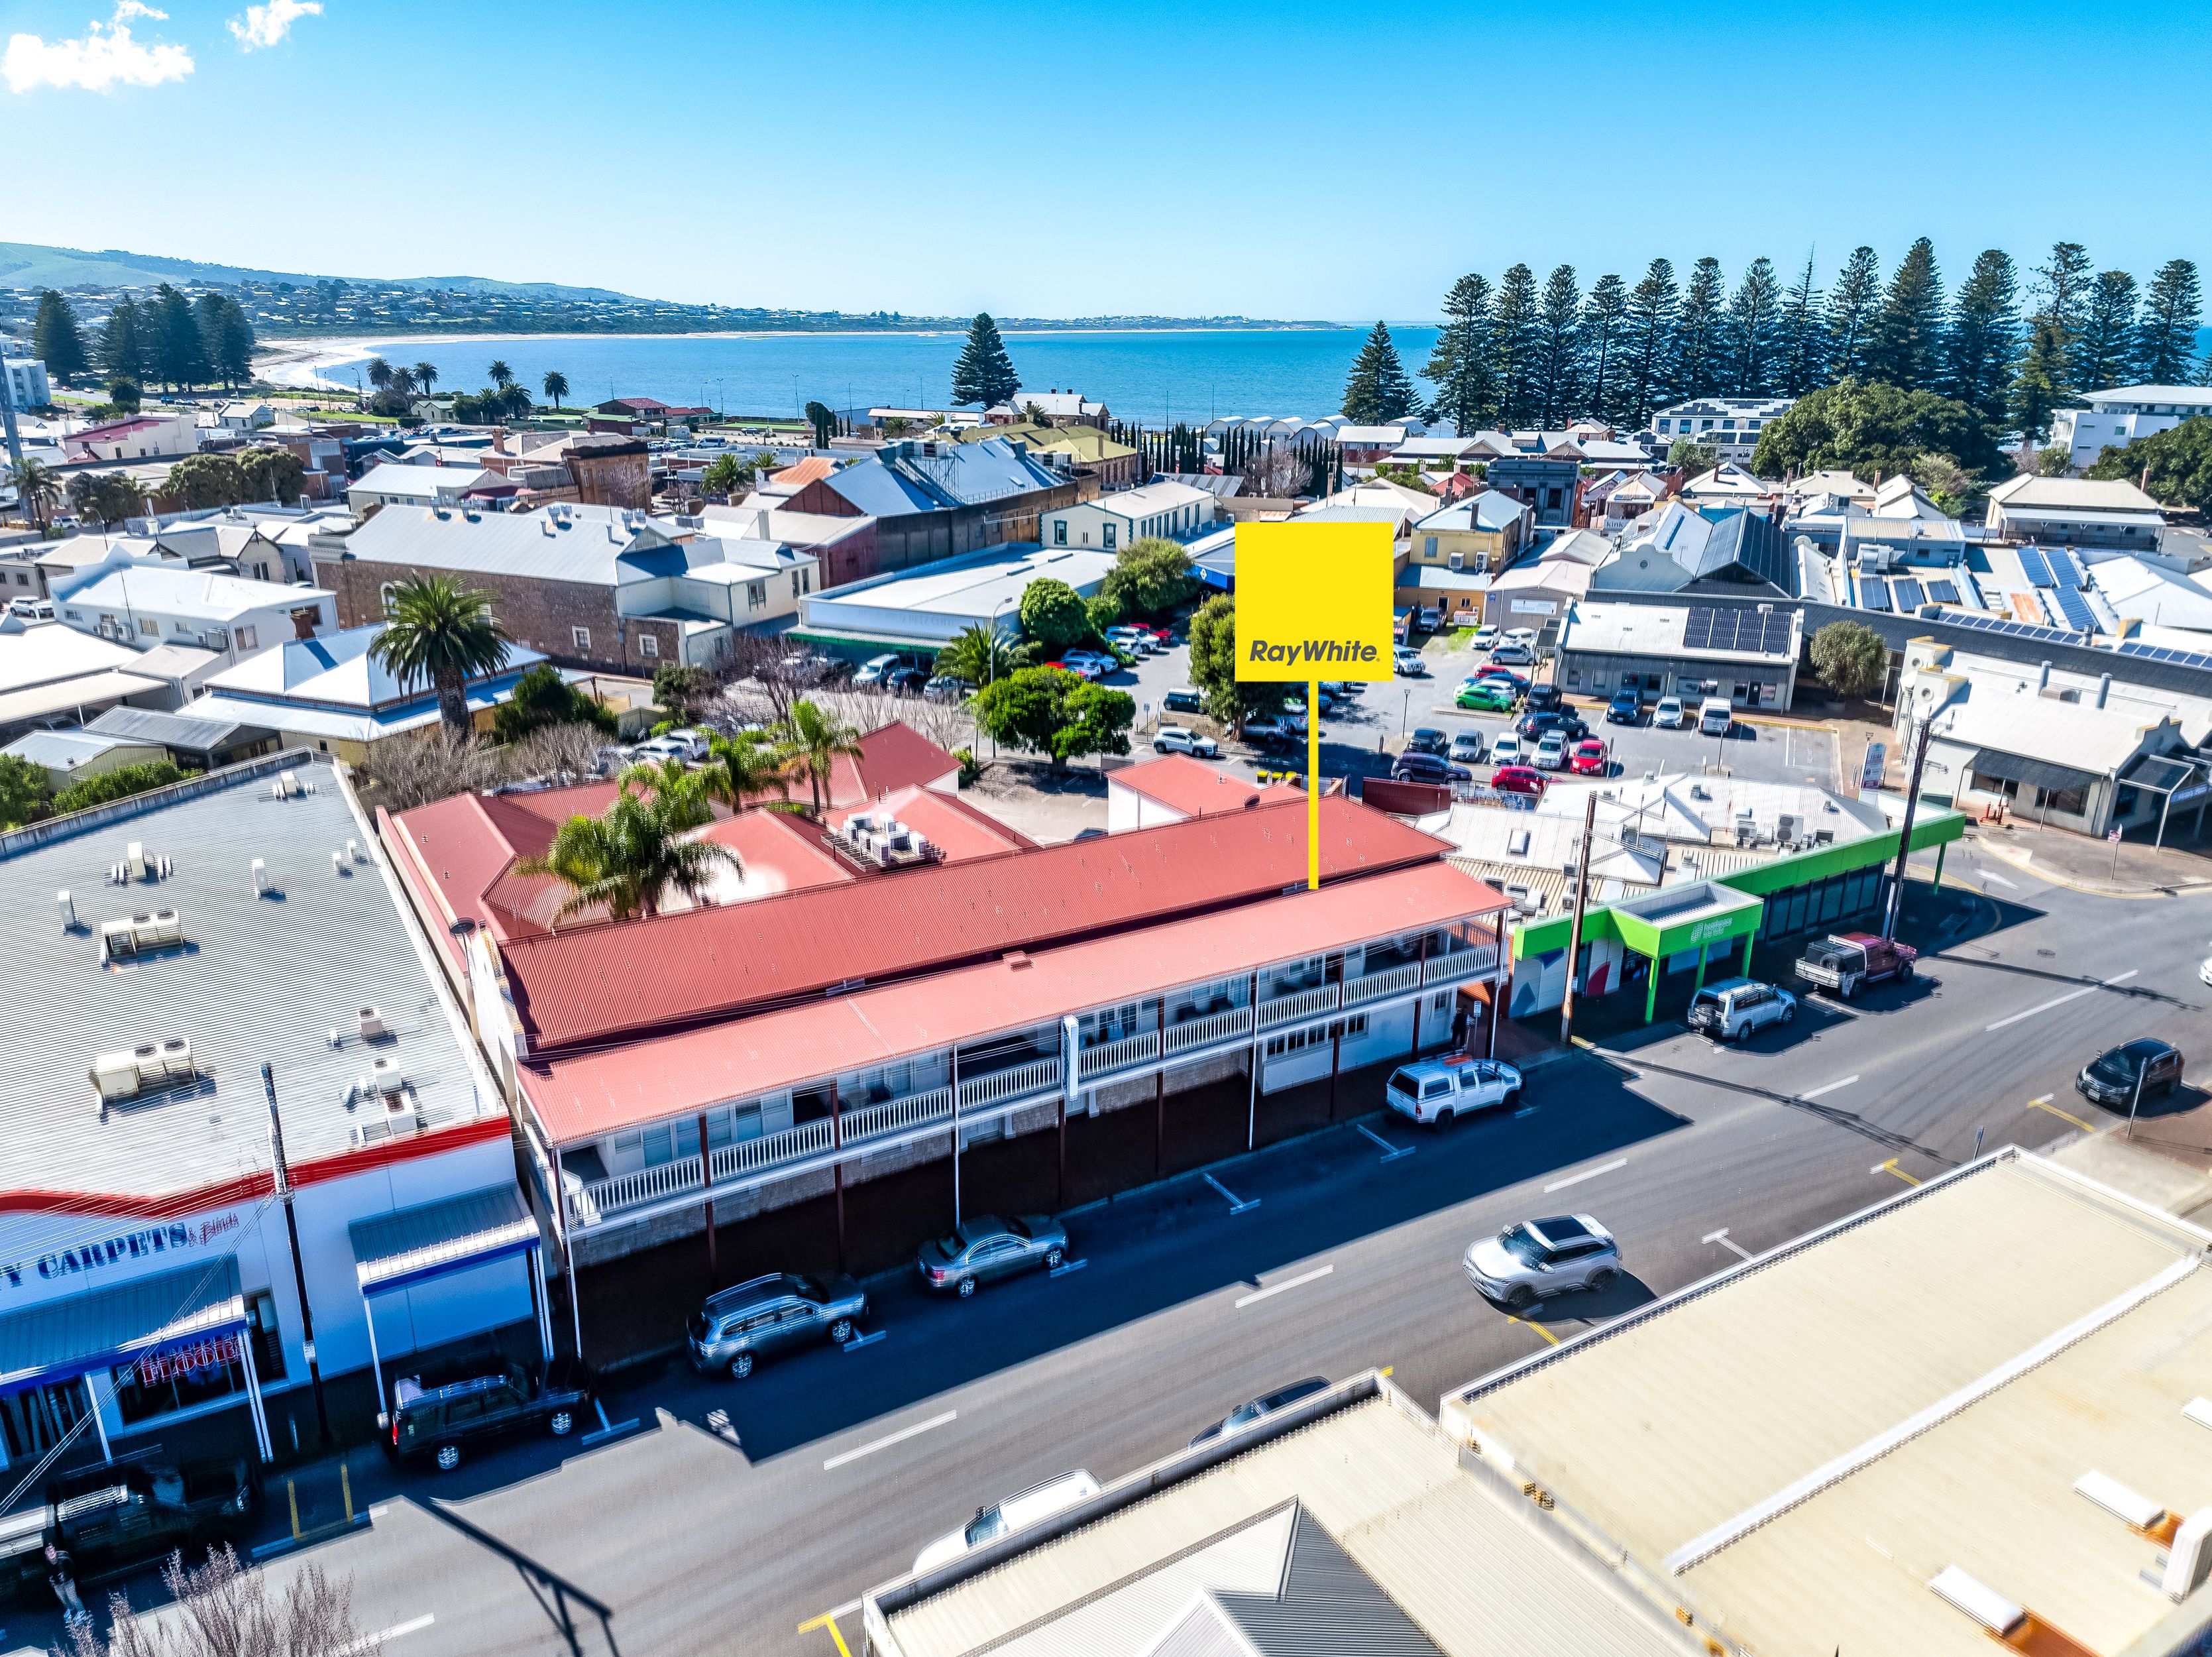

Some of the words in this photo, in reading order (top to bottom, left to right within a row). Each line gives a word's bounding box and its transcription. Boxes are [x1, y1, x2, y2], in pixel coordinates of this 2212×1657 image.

[37, 1222, 188, 1280] CARPETS
[188, 1227, 198, 1247] &
[199, 1212, 240, 1247] Blinds
